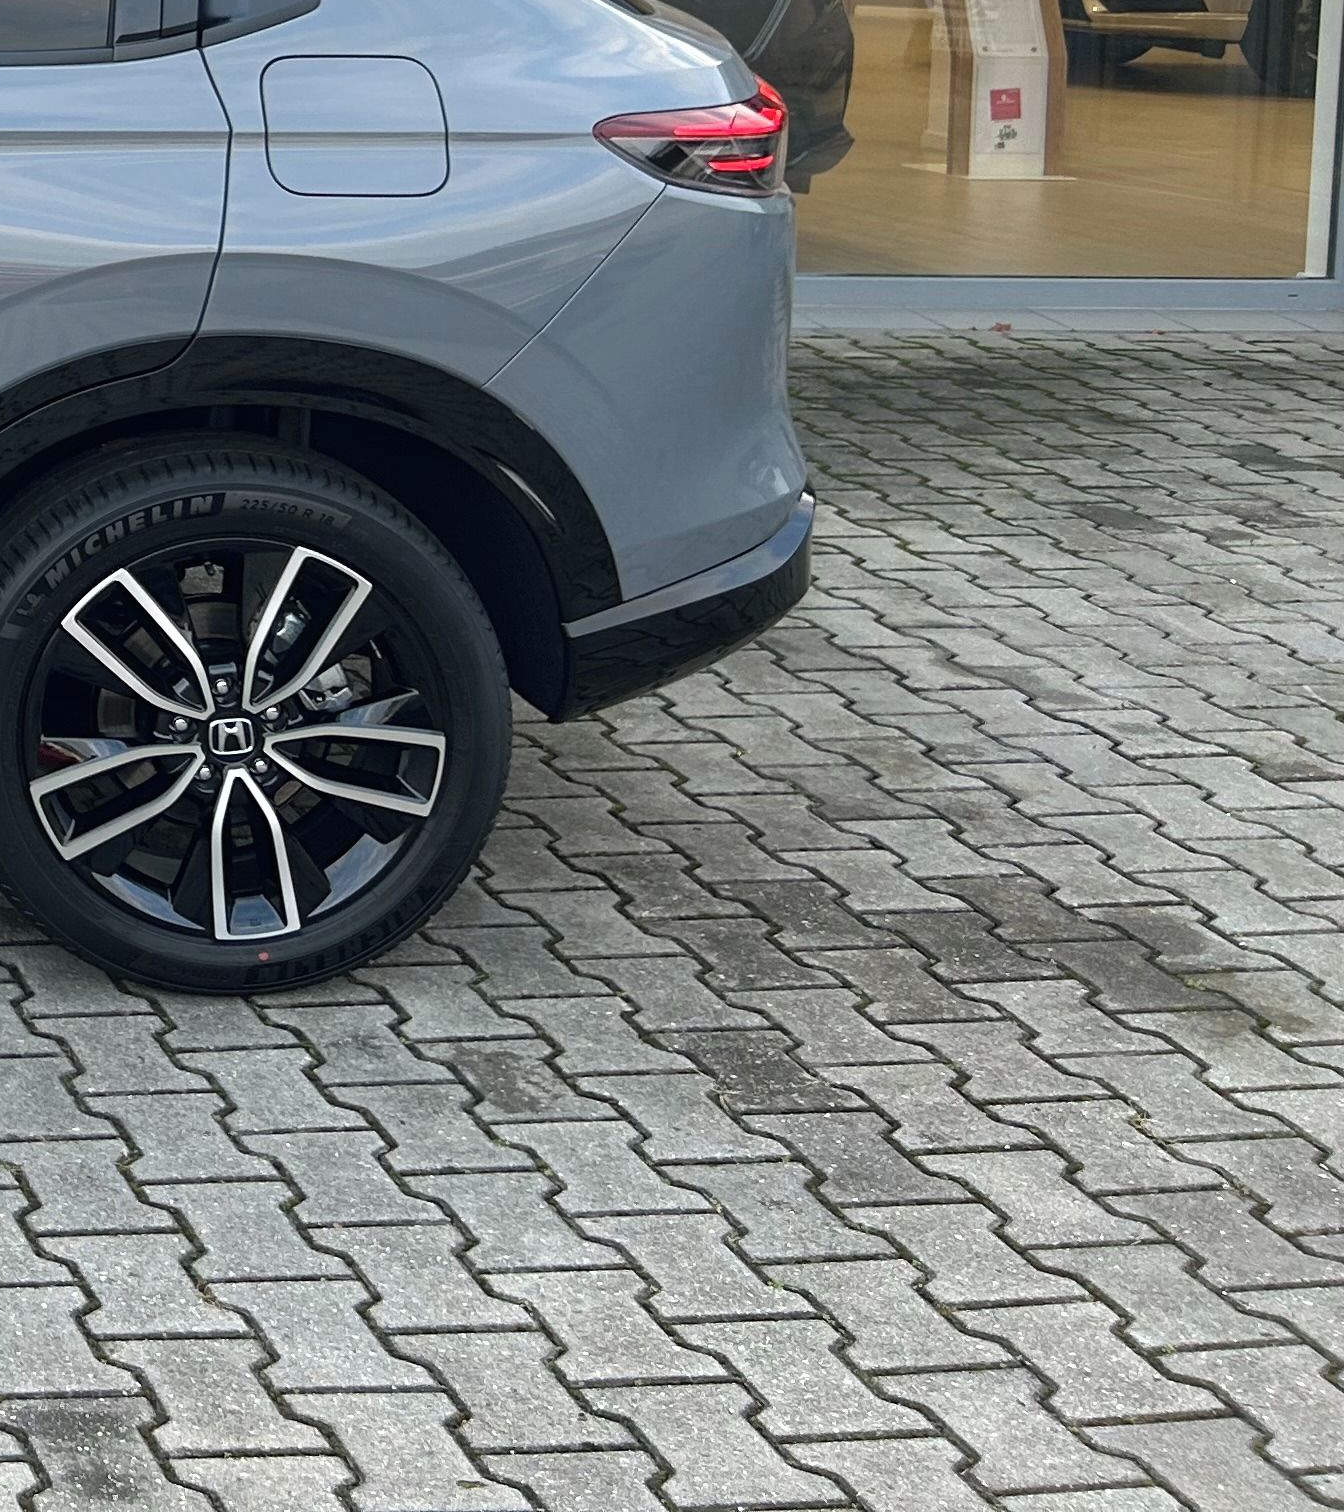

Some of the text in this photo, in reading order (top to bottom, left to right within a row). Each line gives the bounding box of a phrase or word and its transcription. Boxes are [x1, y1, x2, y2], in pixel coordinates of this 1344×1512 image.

[44, 494, 335, 589] MICHELIN 225/50 R 18
